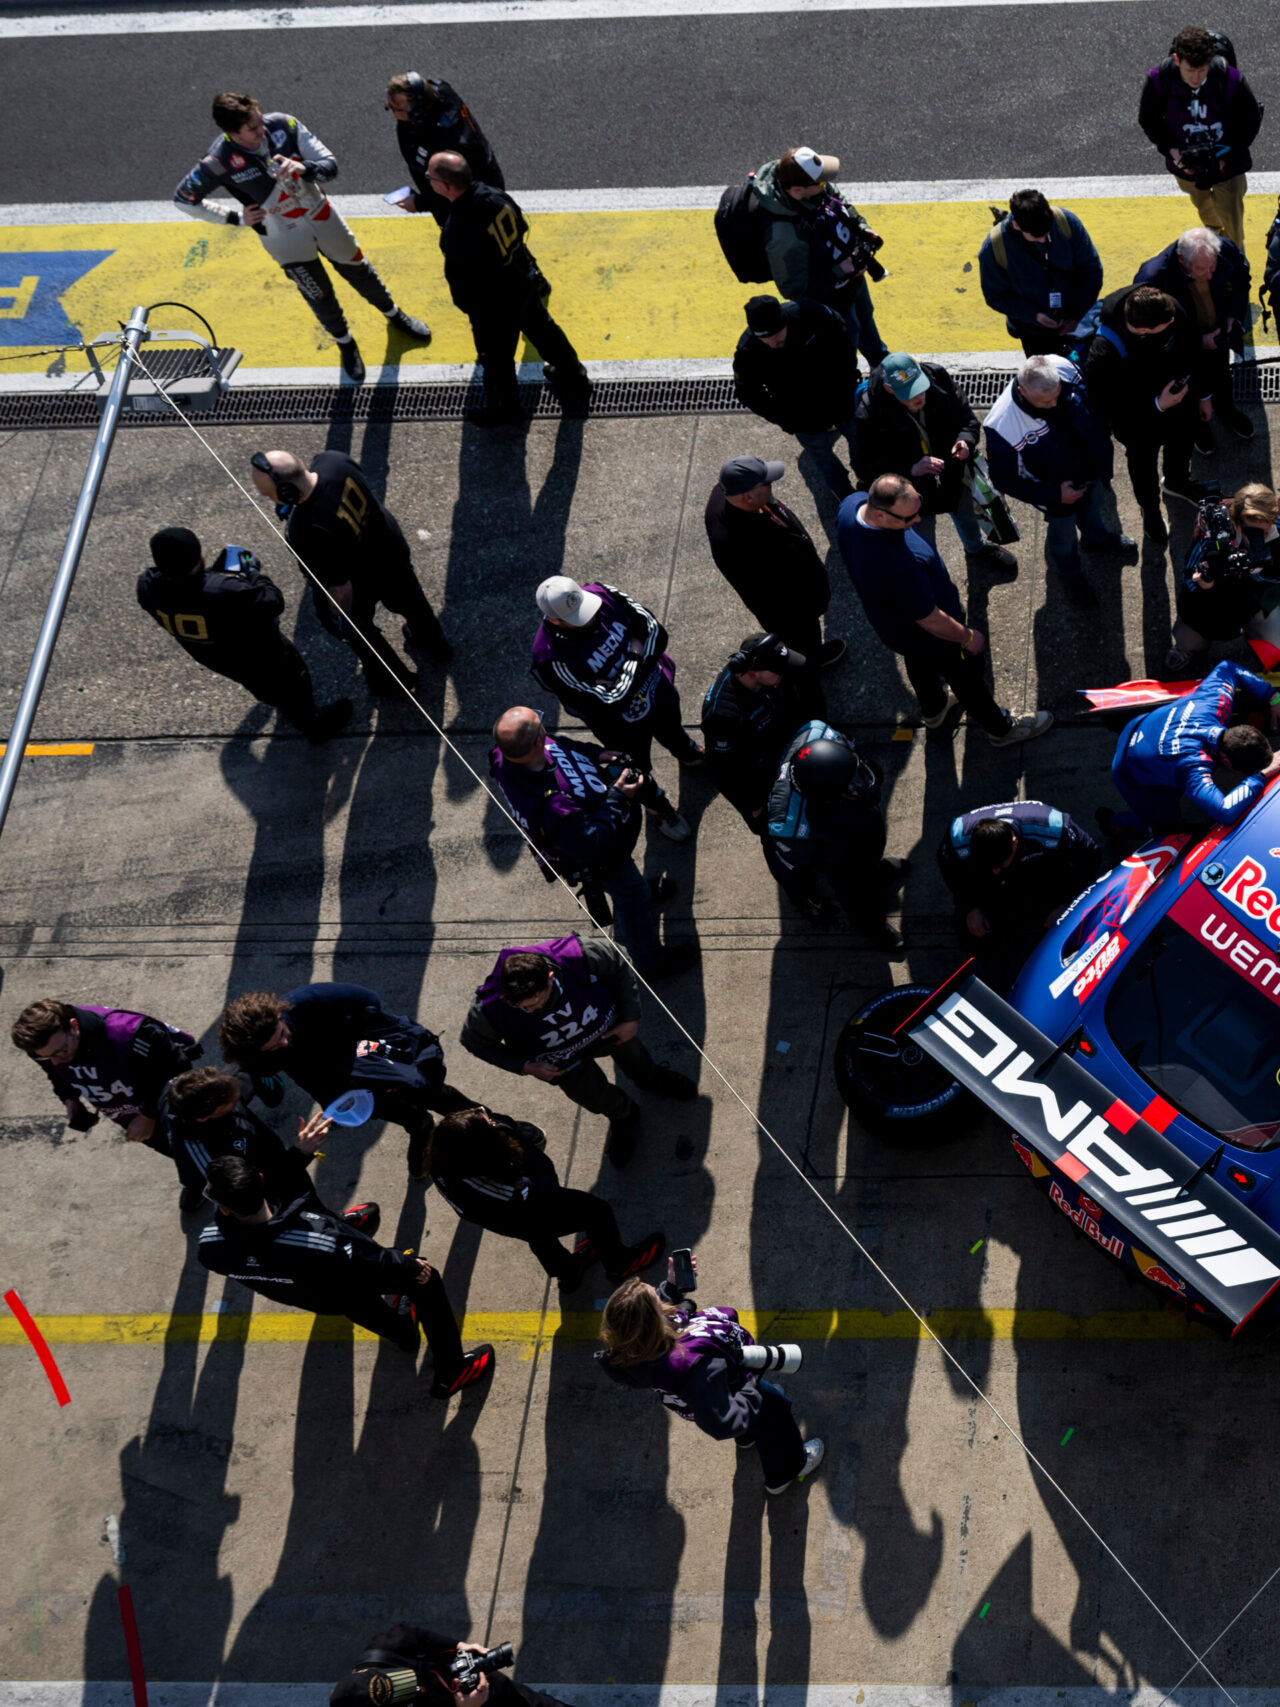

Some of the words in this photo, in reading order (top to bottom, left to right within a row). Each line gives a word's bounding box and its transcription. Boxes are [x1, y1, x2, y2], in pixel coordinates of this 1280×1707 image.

[487, 204, 519, 258] 10
[156, 609, 208, 640] 10
[586, 620, 628, 674] MEDIA
[545, 743, 586, 799] MEDIA
[1072, 935, 1121, 998] auto
[539, 1003, 600, 1049] 224
[541, 1001, 573, 1025] TV
[68, 1065, 99, 1080] TV
